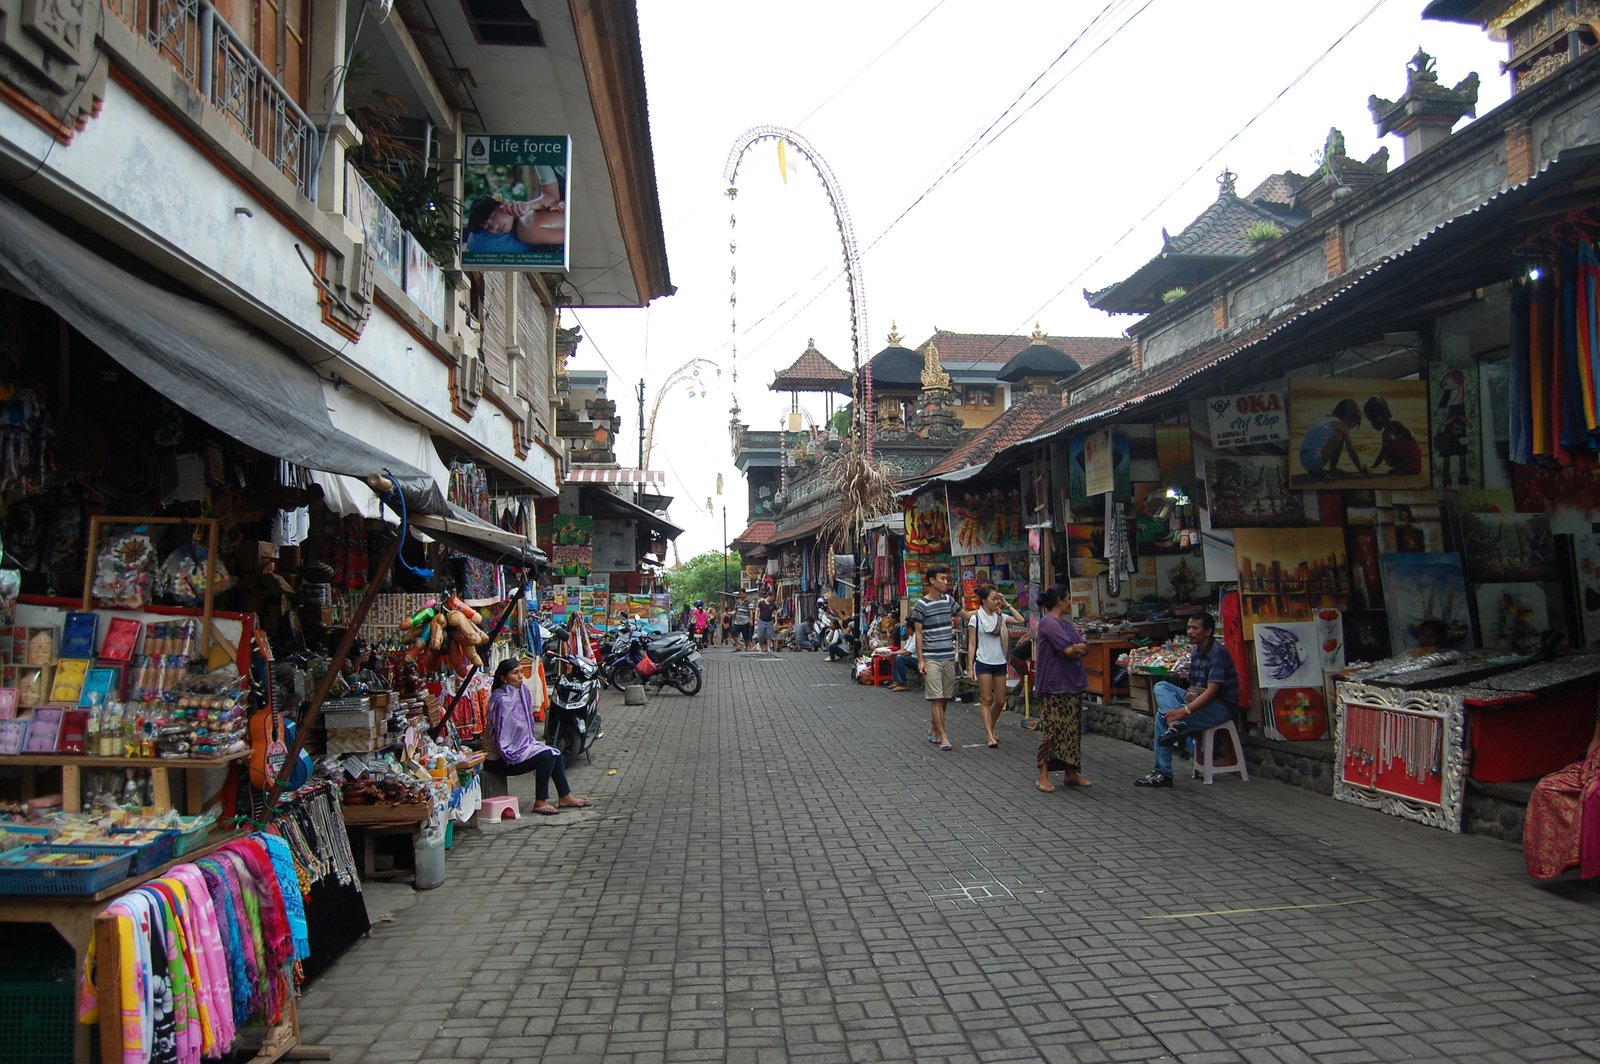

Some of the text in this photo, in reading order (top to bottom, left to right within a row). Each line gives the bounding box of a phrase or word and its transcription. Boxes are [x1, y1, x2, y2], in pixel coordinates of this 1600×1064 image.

[493, 139, 562, 153] Life force
[1236, 393, 1282, 415] OKA
[1253, 414, 1279, 430] Shop
